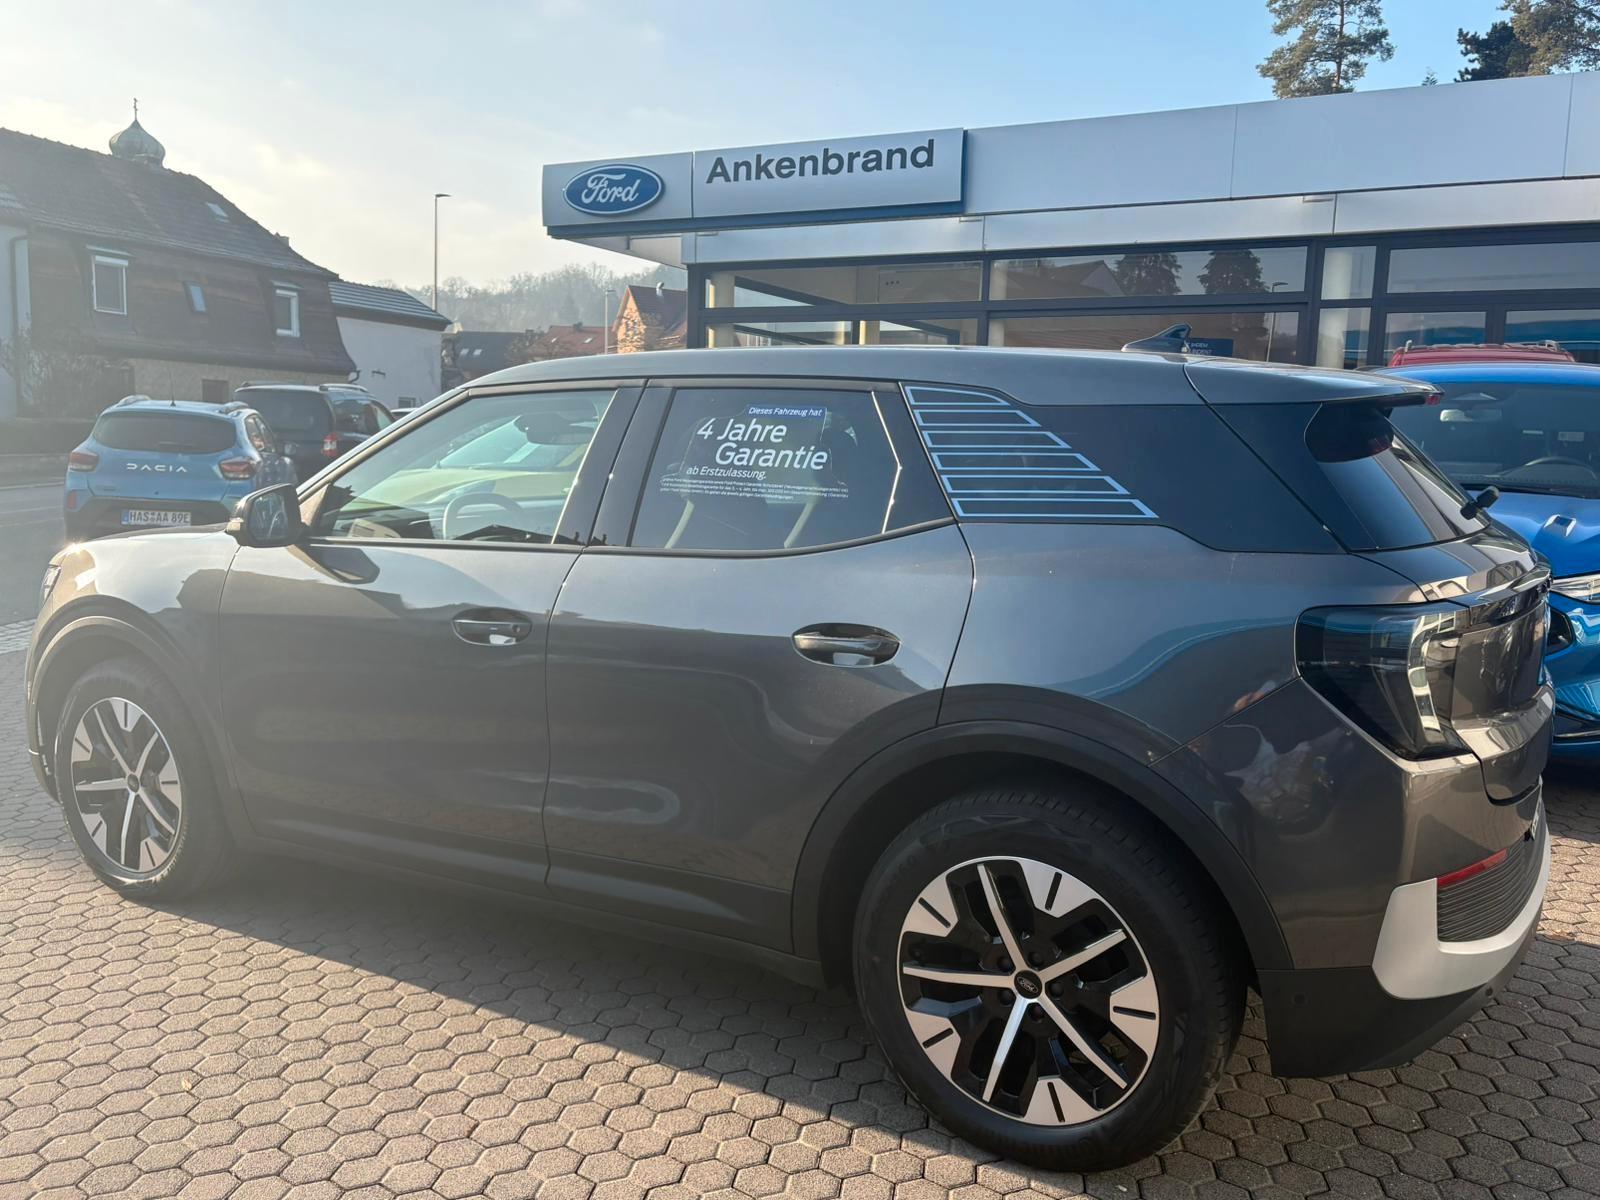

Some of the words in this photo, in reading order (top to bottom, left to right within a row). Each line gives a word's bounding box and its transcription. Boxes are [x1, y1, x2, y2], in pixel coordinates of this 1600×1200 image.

[705, 138, 935, 185] Ankenbrand
[581, 172, 639, 205] Ford
[748, 406, 773, 415] Dieses
[774, 408, 808, 417] Fahrzeug
[808, 409, 823, 417] hat
[697, 418, 716, 439] 4
[717, 418, 787, 442] Jahre
[716, 442, 828, 470] Garantie
[127, 463, 187, 472] DACIA
[686, 466, 699, 475] ab
[699, 466, 767, 480] Erstzulassung.
[171, 512, 190, 524] 89E
